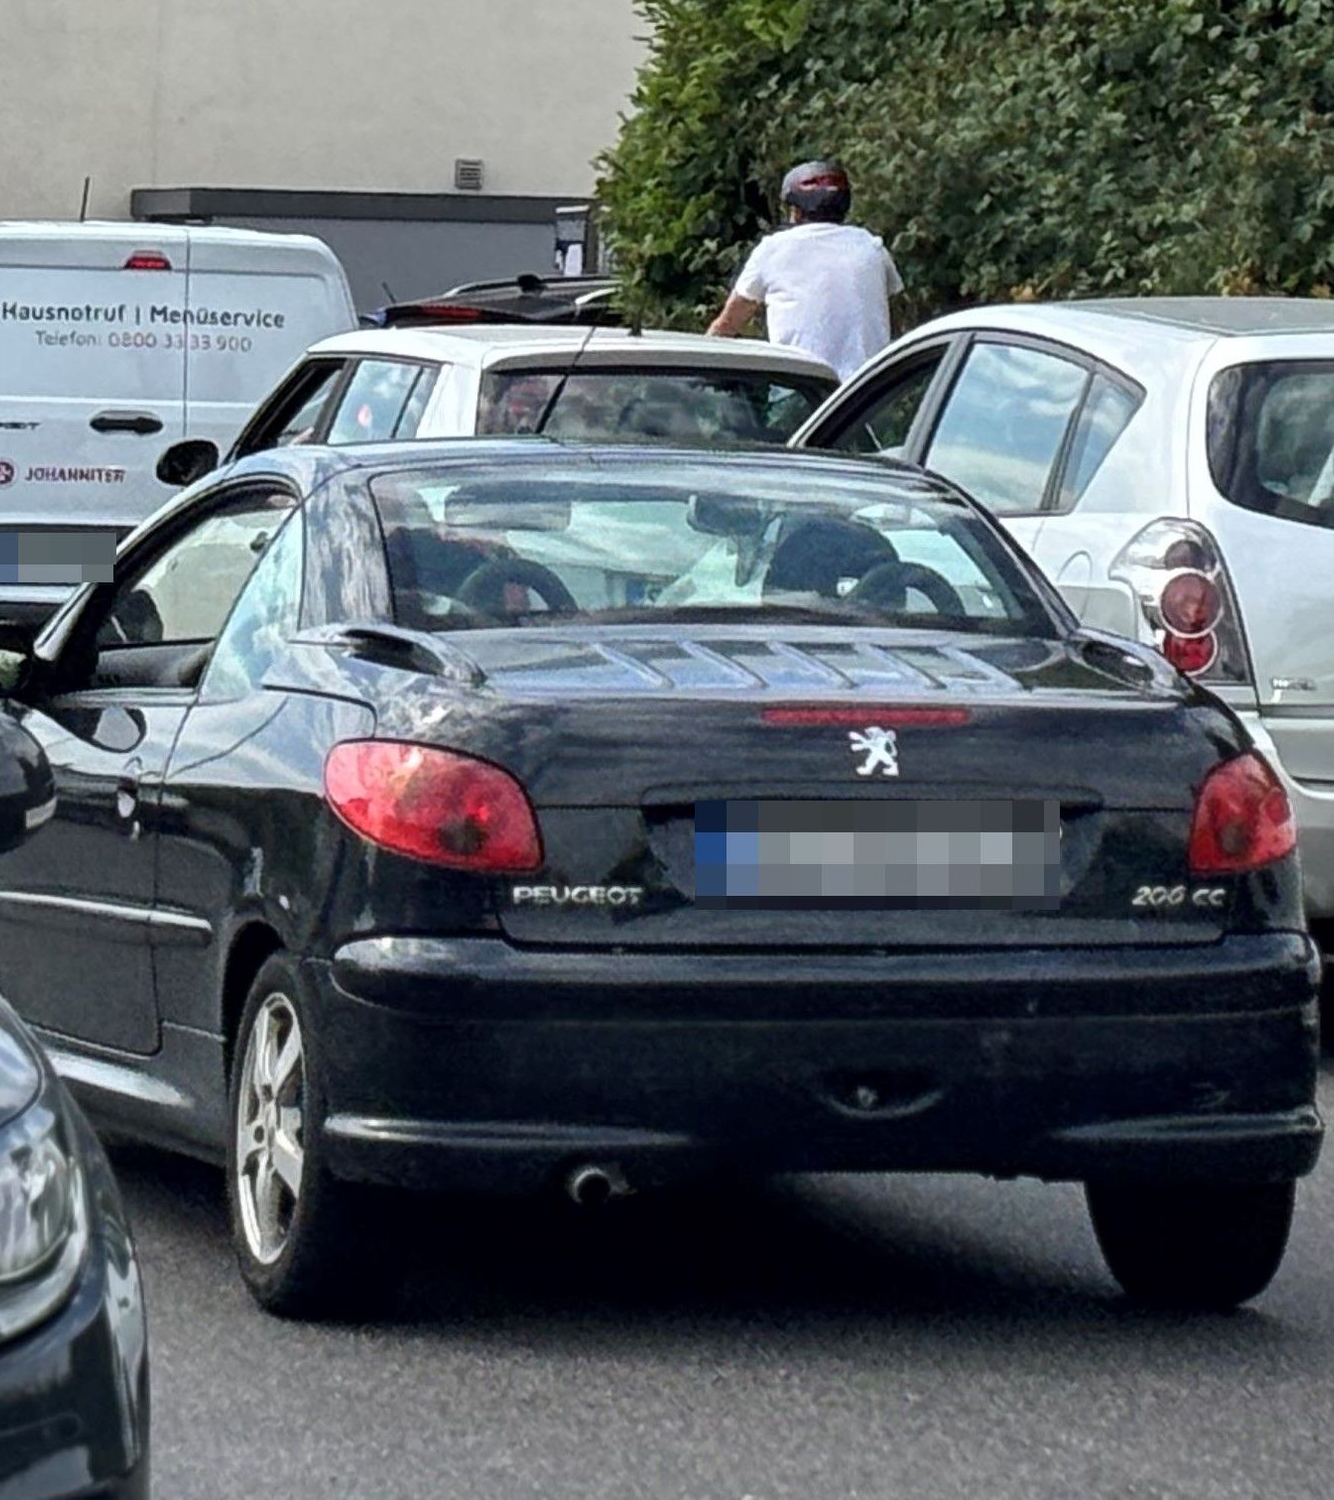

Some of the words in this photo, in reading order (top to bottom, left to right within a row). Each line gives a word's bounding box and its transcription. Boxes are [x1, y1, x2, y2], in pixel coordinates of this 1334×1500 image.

[2, 301, 126, 322] Hausnotruf
[150, 305, 285, 328] Menüservice
[35, 330, 102, 347] Telefon:
[108, 331, 157, 348] 0800
[216, 335, 252, 352] 900
[25, 467, 125, 483] JOHANNITER
[513, 885, 644, 905] PEUGEOT
[1131, 884, 1186, 907] 206
